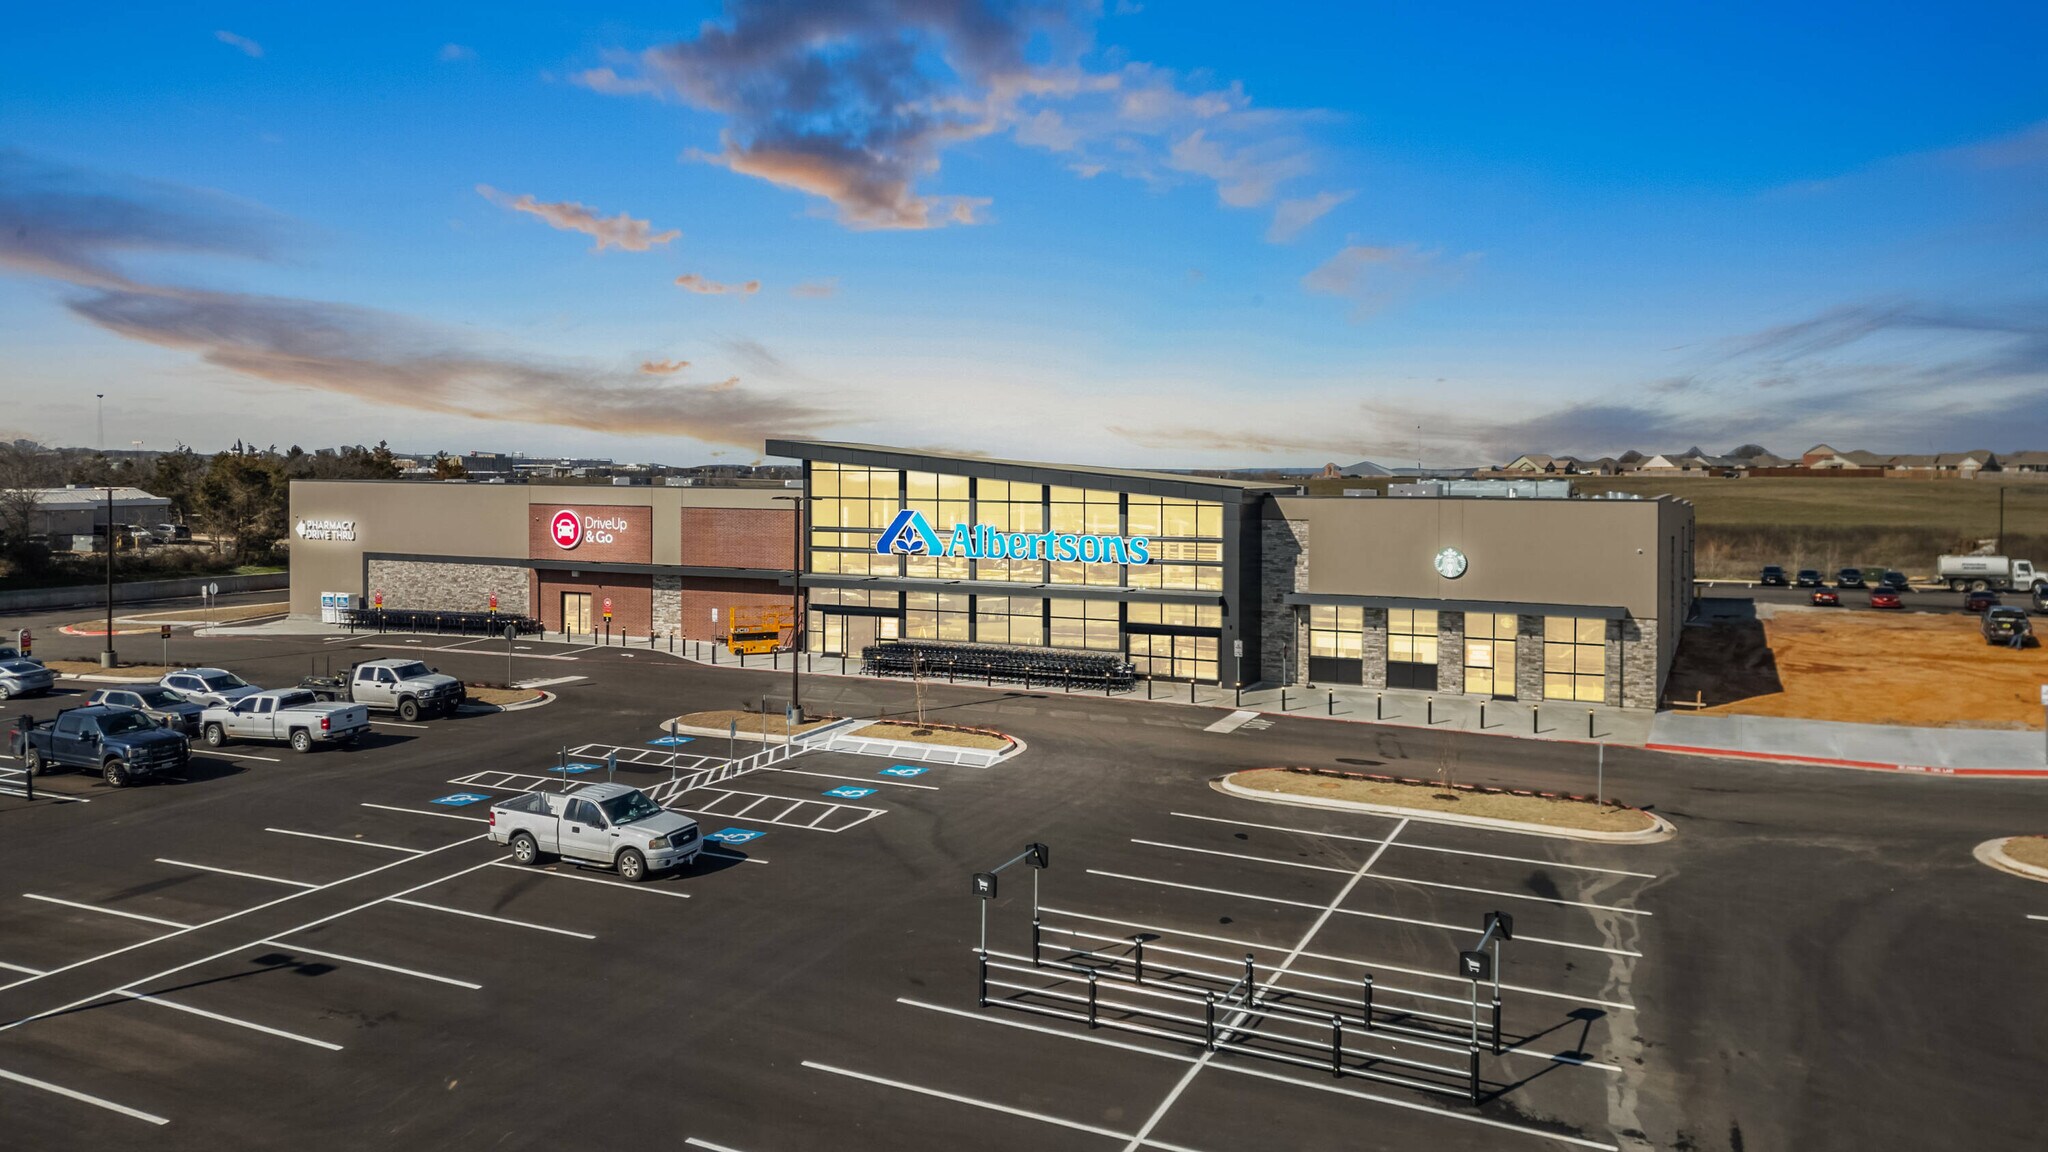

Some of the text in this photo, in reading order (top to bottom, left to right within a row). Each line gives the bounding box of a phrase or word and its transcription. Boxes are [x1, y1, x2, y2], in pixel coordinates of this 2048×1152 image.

[307, 520, 354, 531] PHARMACY
[585, 516, 627, 533] DriveUp
[306, 530, 355, 541] DRIVE THRU
[585, 530, 613, 543] & Go
[947, 523, 1150, 565] Albertsons
